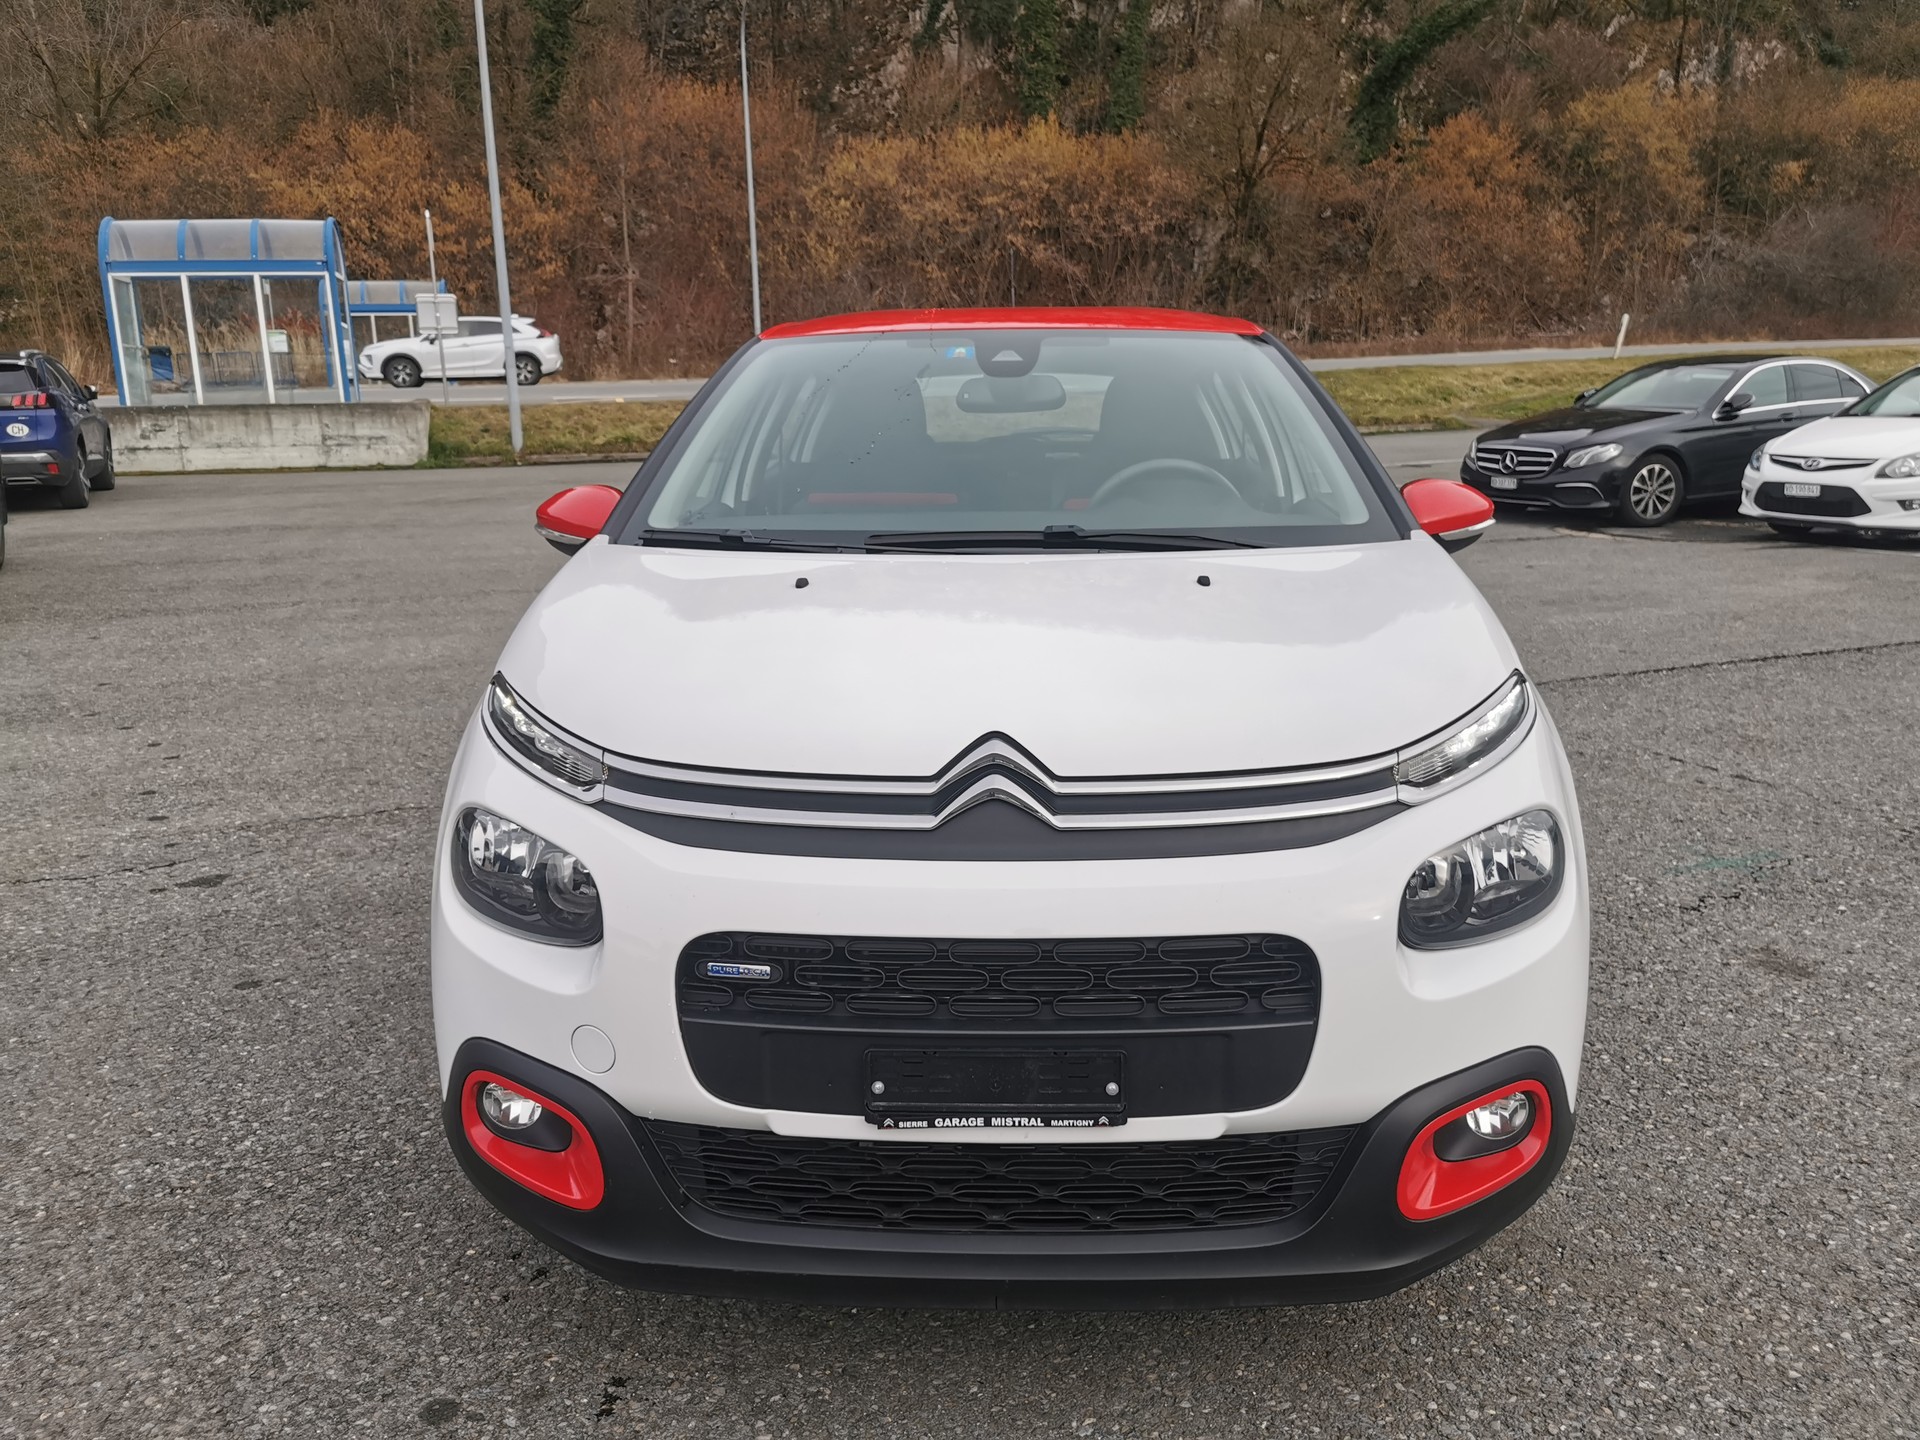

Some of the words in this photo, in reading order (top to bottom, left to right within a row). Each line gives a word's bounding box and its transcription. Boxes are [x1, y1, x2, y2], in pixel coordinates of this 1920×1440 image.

[11, 425, 25, 435] CH
[934, 1118, 985, 1127] GARAGE
[991, 1117, 1045, 1127] MISTRAL
